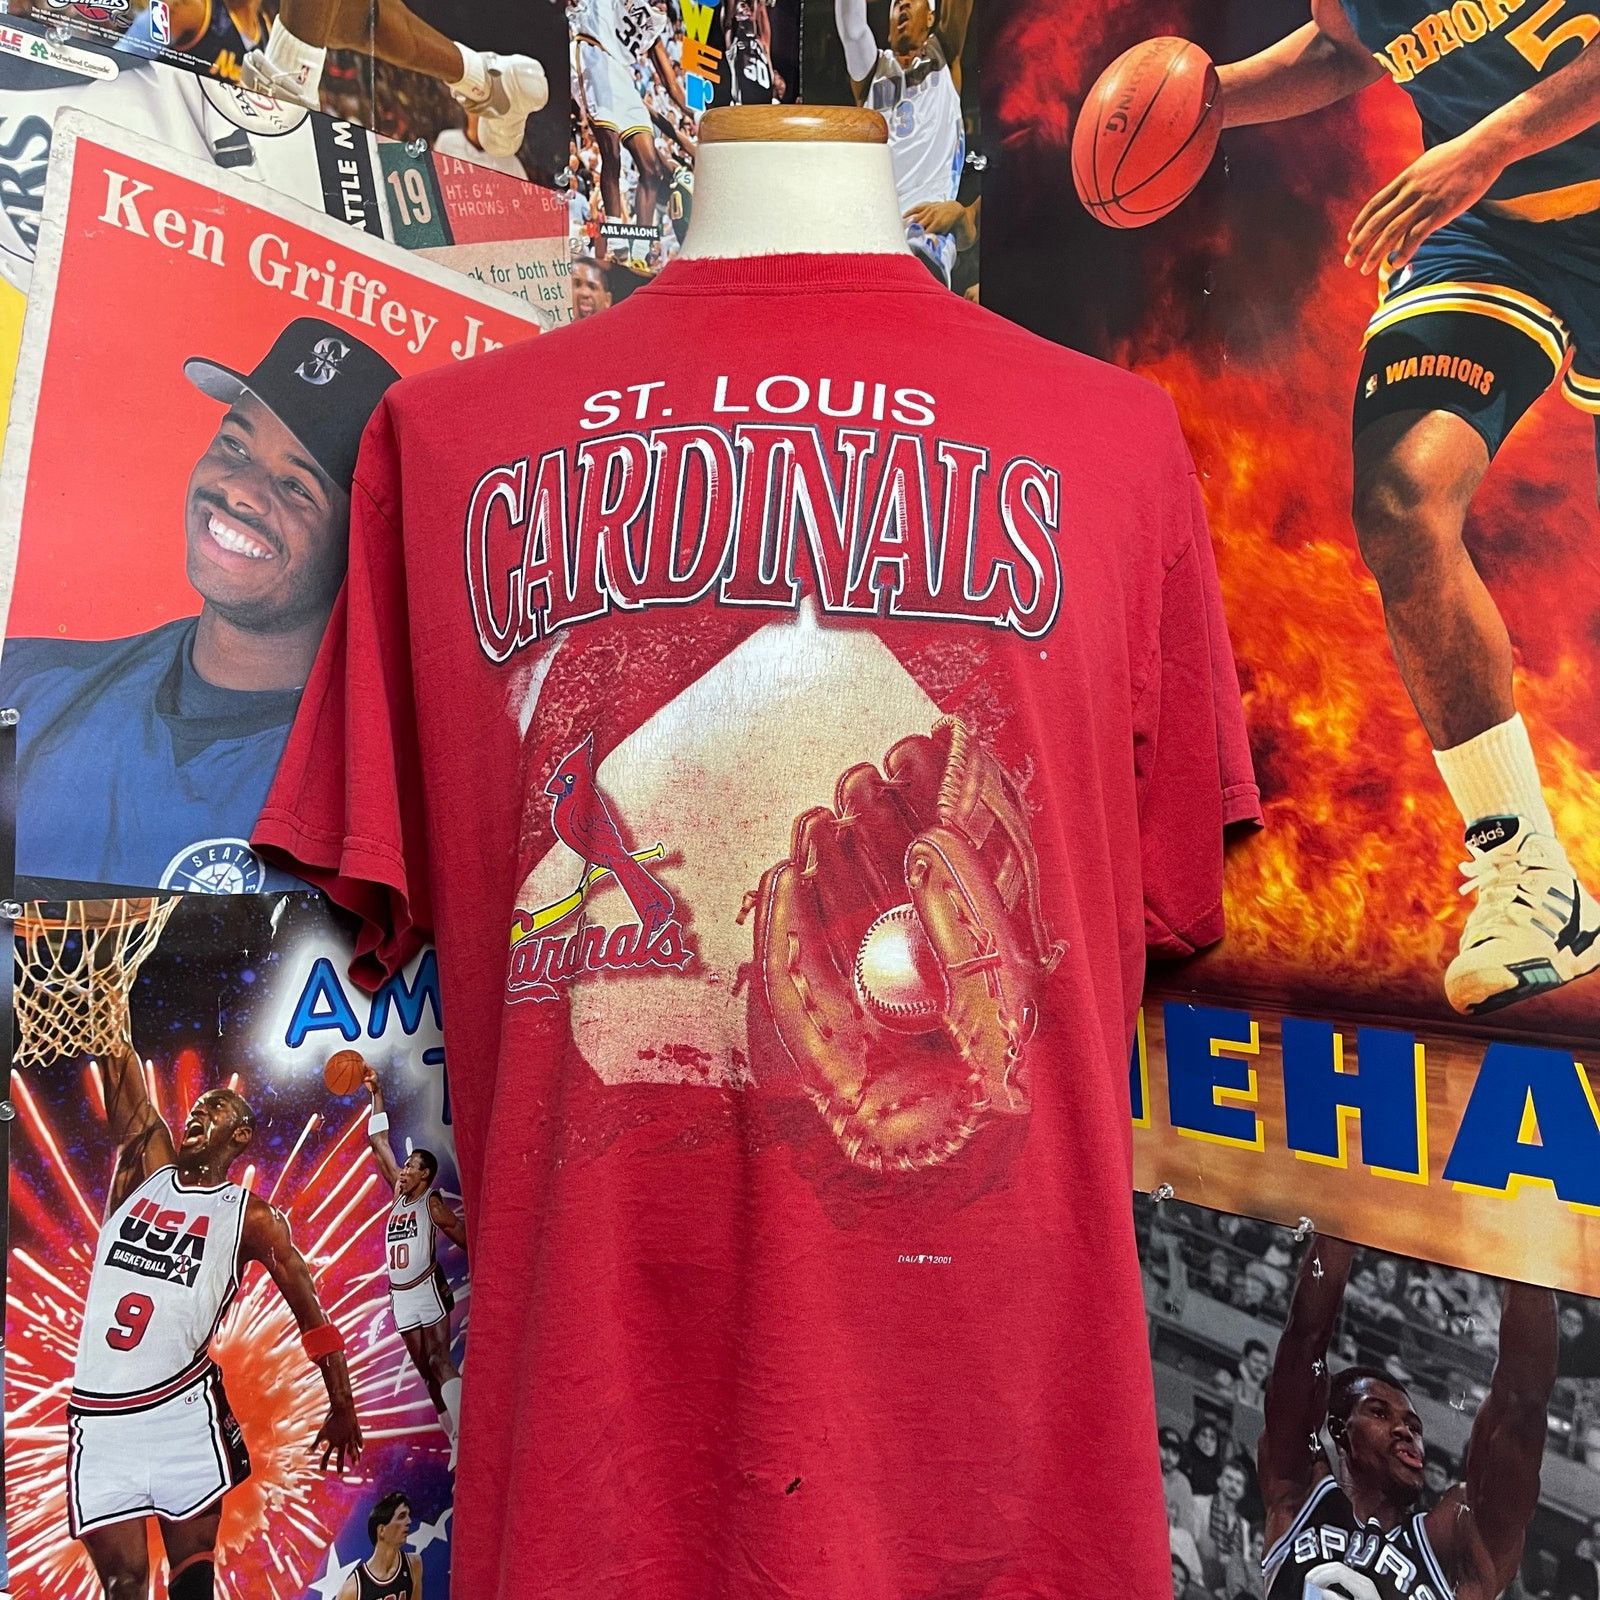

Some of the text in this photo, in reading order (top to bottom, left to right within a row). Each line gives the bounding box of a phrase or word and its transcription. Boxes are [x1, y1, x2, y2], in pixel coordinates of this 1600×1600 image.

[0, 30, 23, 46] LE
[387, 168, 432, 226] 19
[620, 227, 658, 238] MALONE
[98, 169, 226, 267] Ken
[248, 232, 439, 354] Griffey
[490, 265, 510, 283] for
[516, 260, 548, 281] both
[538, 282, 564, 301] last
[1385, 354, 1495, 395] WARRIORS
[579, 375, 937, 430] ST. LOUIS
[464, 423, 1063, 664] CARDINALS
[191, 846, 257, 892] SEATTLE
[1131, 1002, 1600, 1217] EHA
[119, 1197, 210, 1261] USA
[389, 1211, 417, 1232] USA
[112, 1249, 166, 1273] BASKETBALL
[390, 1243, 409, 1269] 10
[105, 1292, 155, 1352] 9
